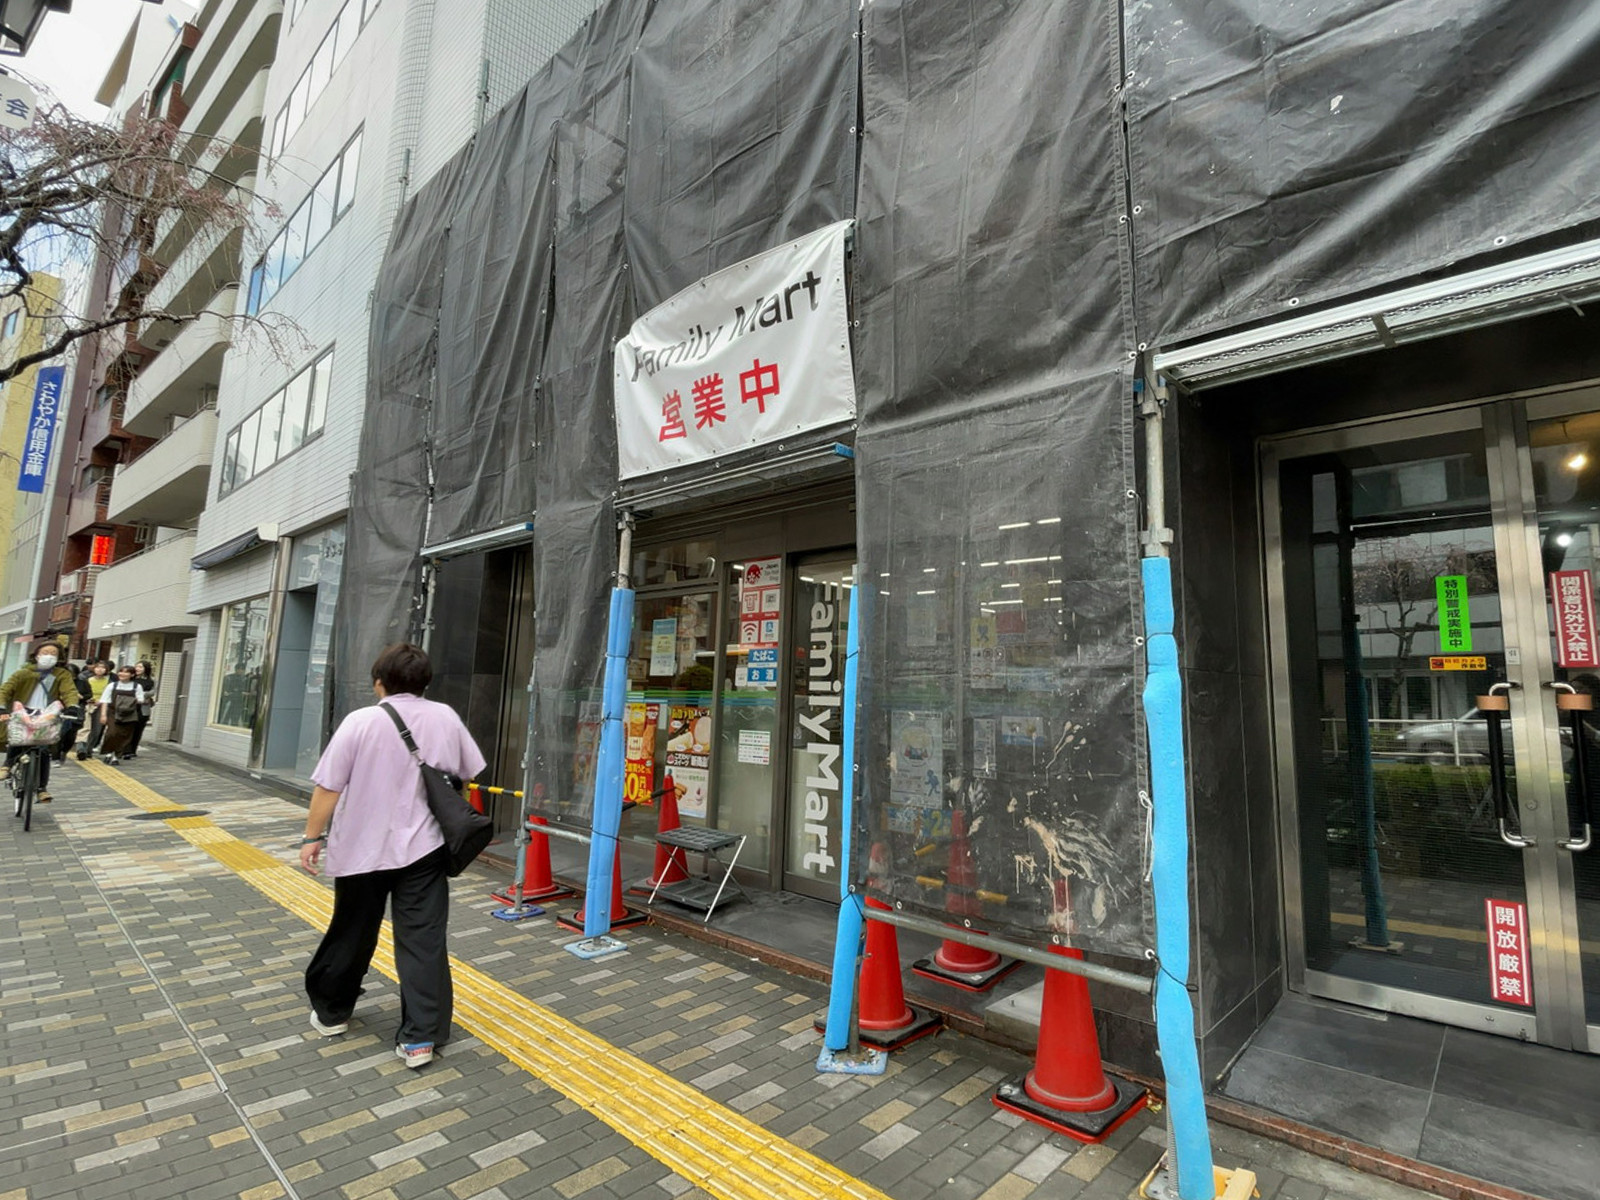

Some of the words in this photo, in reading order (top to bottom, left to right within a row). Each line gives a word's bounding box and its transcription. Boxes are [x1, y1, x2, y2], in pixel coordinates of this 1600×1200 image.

[631, 322, 723, 382] Family
[728, 270, 822, 342] Mart
[24, 380, 58, 477] さわやか信用金庫
[659, 358, 781, 443] 営業中
[753, 650, 775, 661] たばこ
[1443, 579, 1463, 648] 特別警戒実施中
[1560, 575, 1590, 662] 関係者以外立入禁止
[1494, 906, 1522, 997] 開放厳禁
